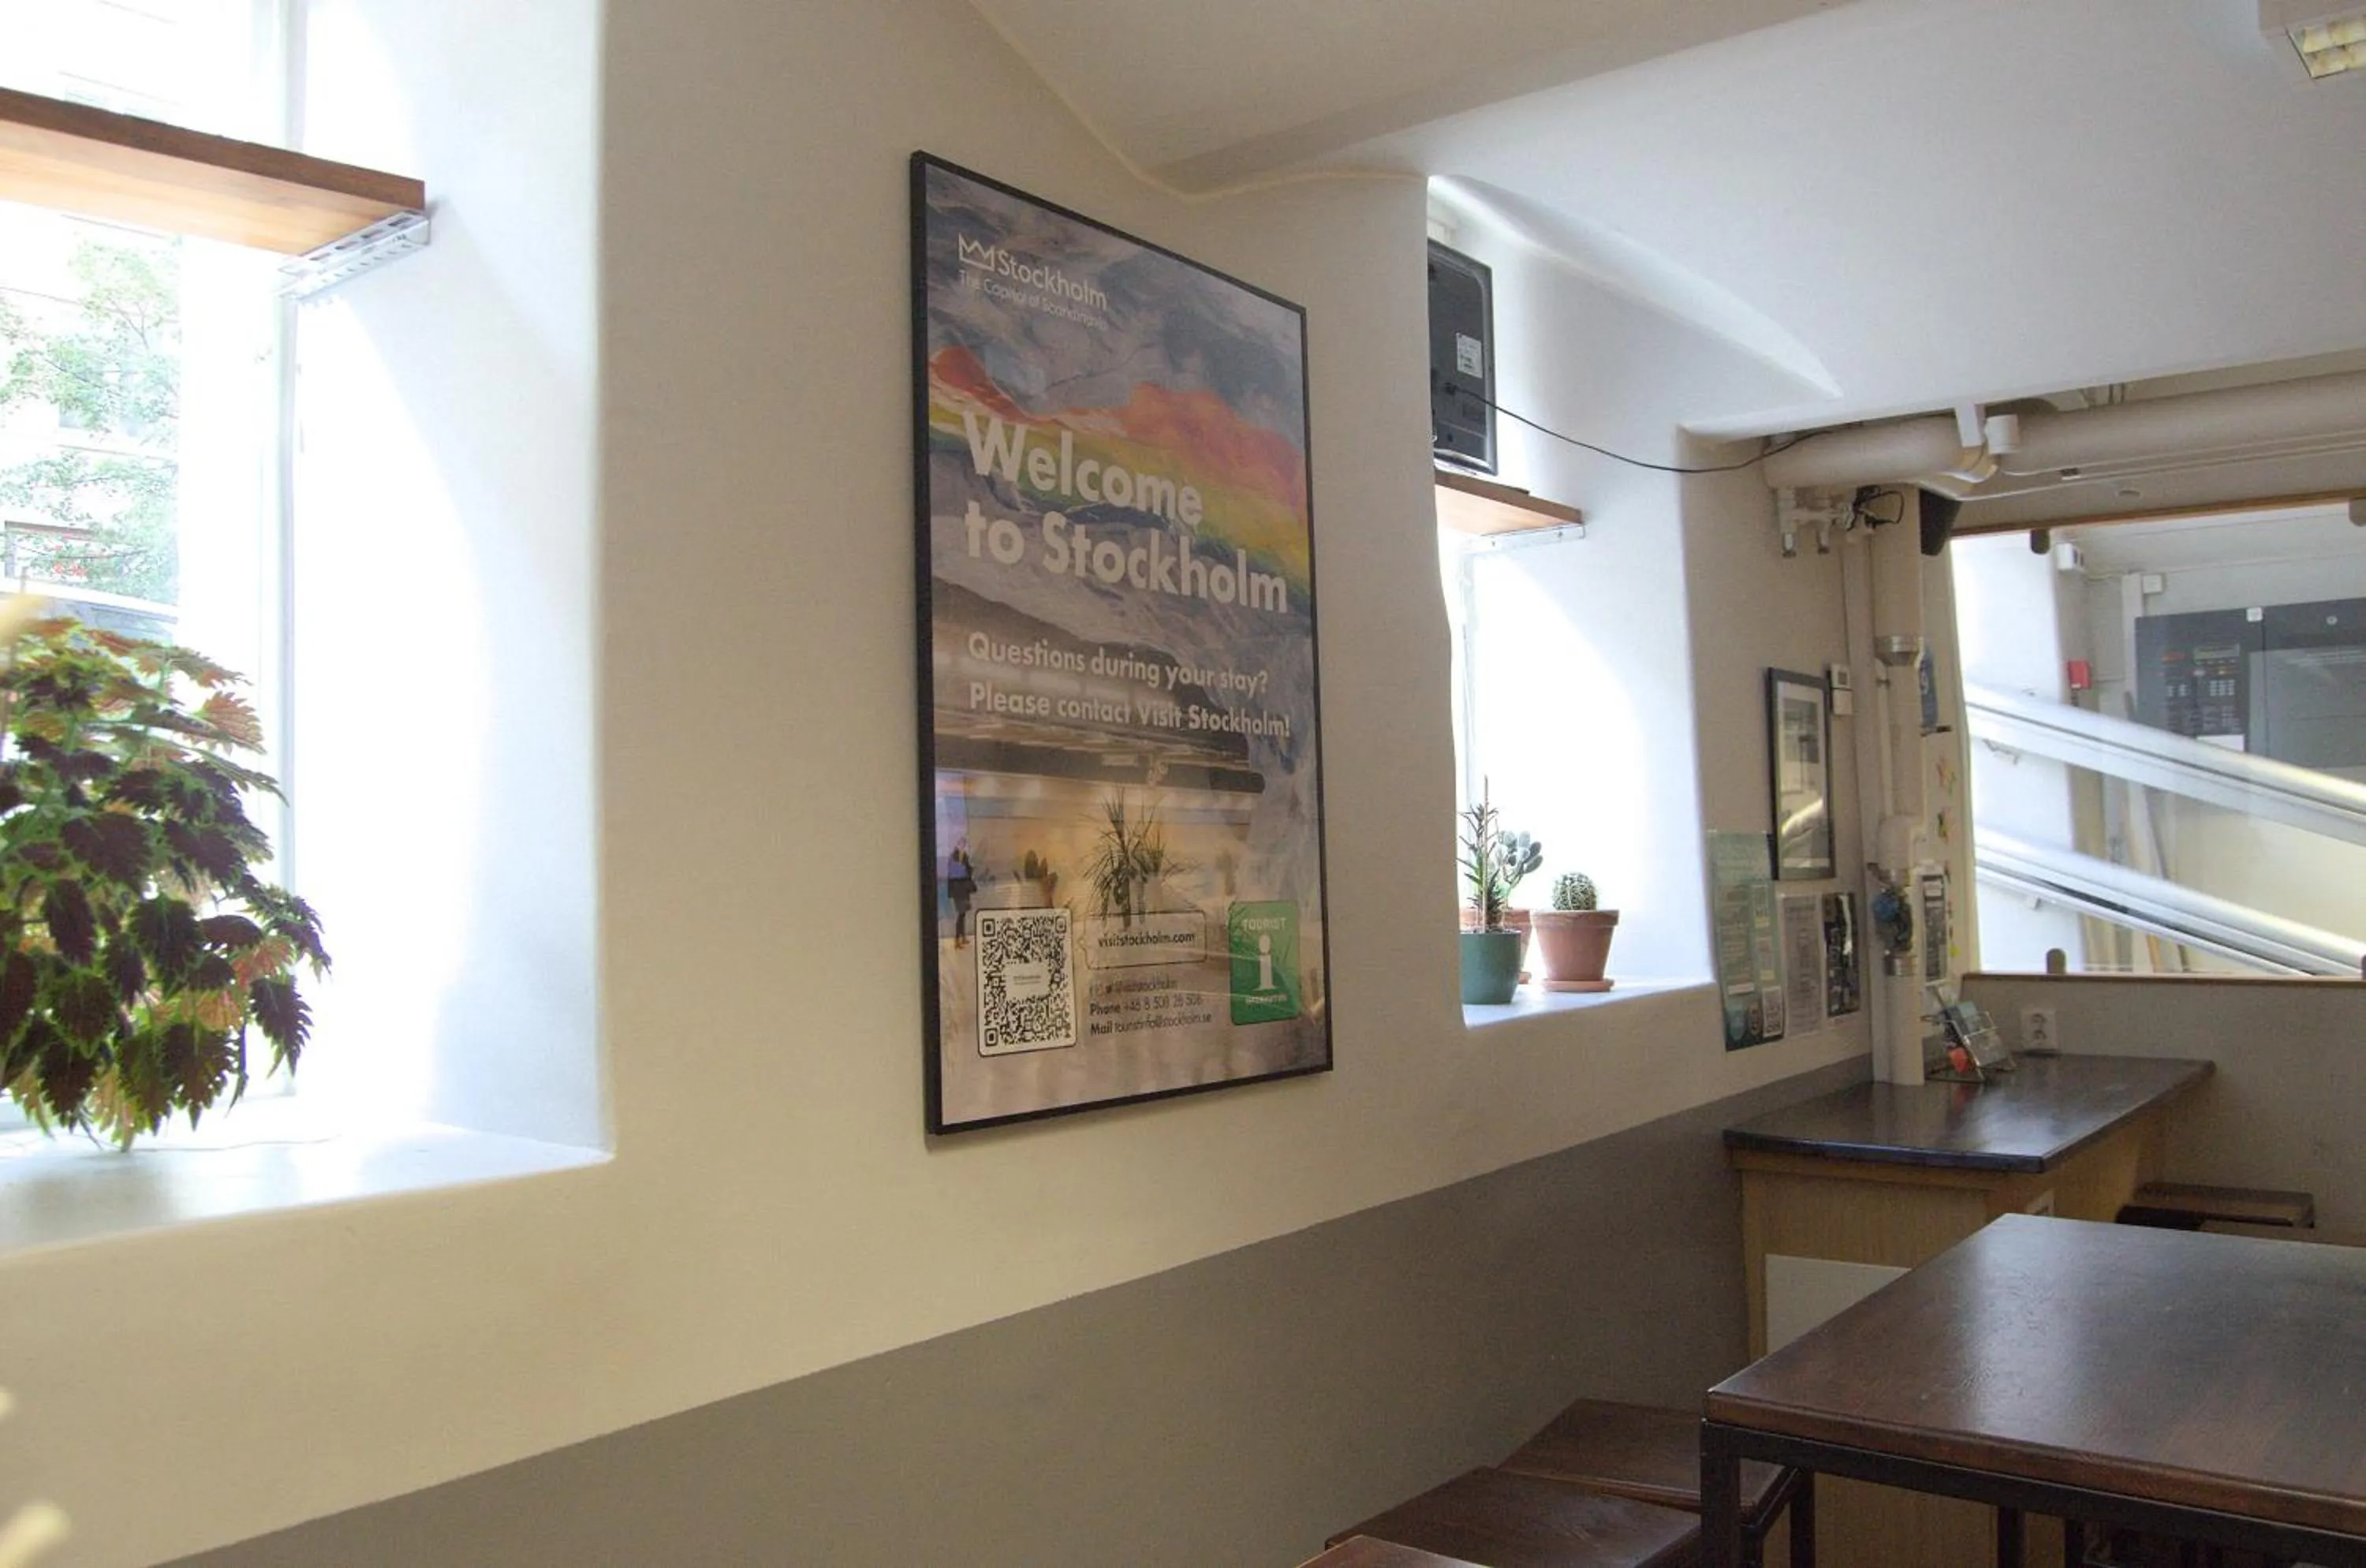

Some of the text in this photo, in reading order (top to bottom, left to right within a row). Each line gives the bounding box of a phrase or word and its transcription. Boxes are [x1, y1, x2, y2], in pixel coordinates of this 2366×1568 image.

[998, 249, 1107, 311] Stockholm
[962, 409, 1204, 527] Welcome
[964, 499, 1287, 614] to Stockholm
[968, 631, 1268, 700] Questions during your stay?
[969, 680, 1290, 737] Please contact Visit Stockholm!
[1098, 931, 1195, 947] visitstockholm.com
[1241, 917, 1287, 931] TOURIST
[1090, 1002, 1121, 1016] Phone
[1090, 1021, 1113, 1036] Mail
